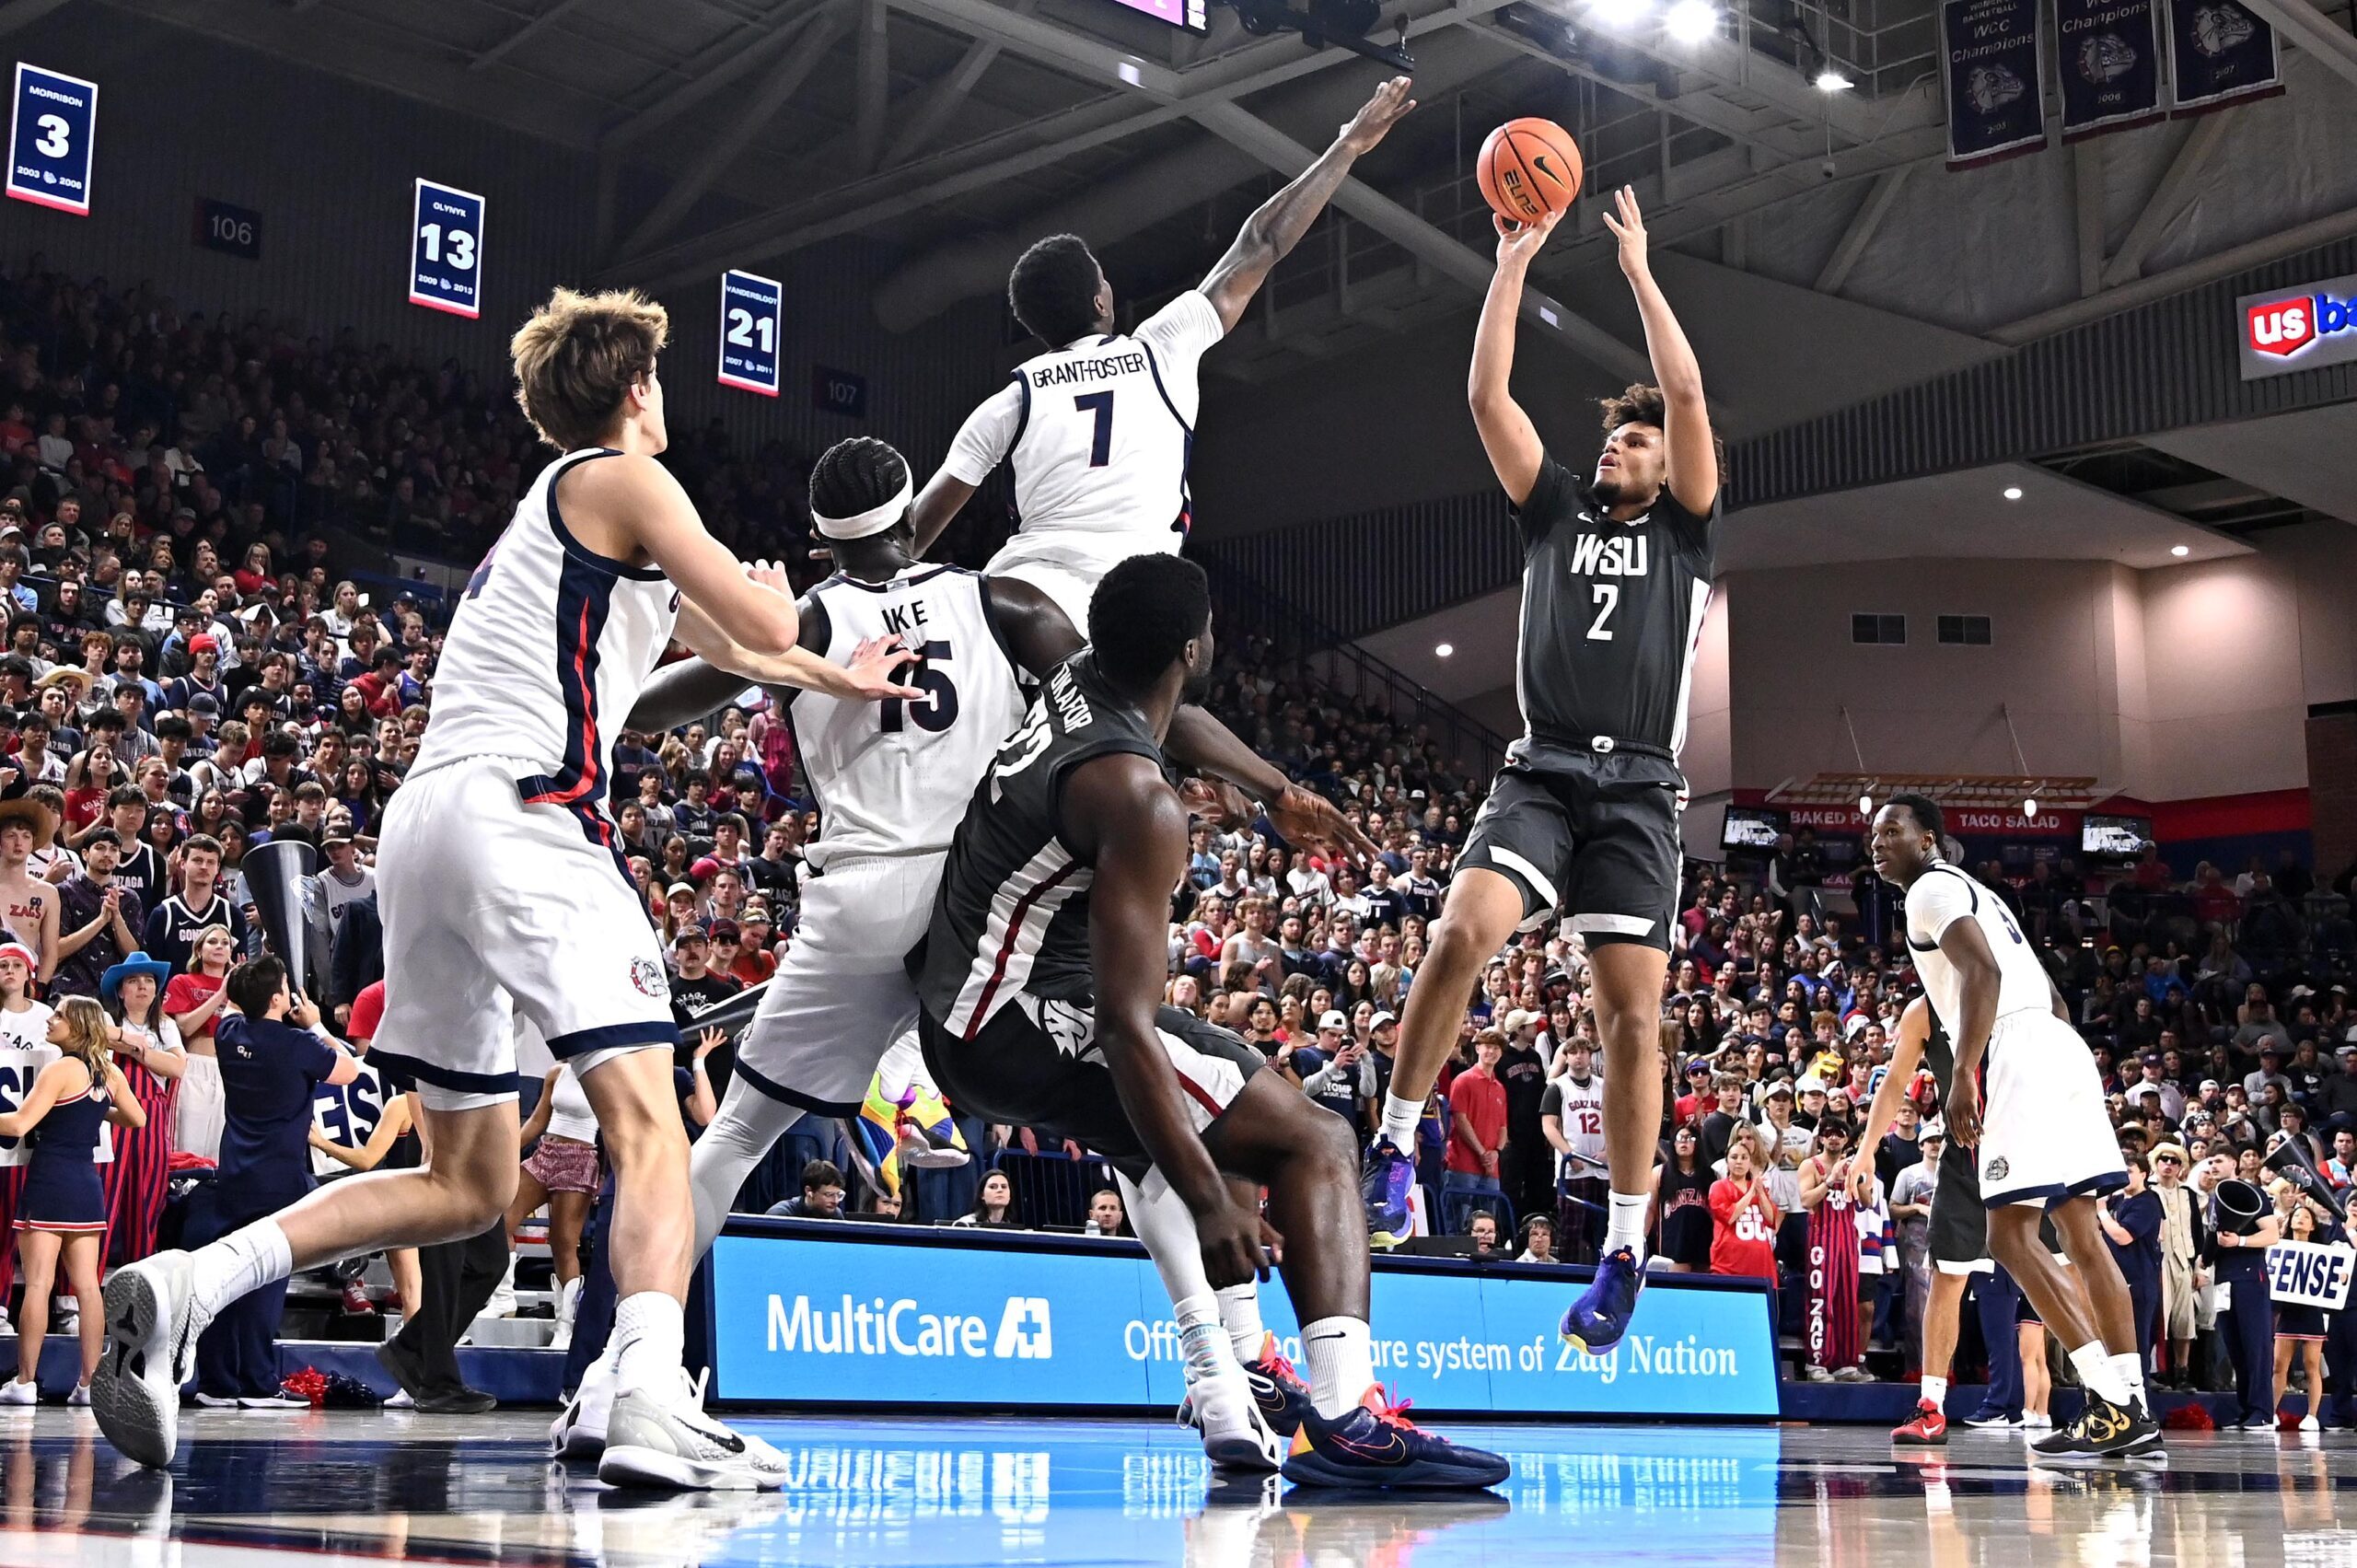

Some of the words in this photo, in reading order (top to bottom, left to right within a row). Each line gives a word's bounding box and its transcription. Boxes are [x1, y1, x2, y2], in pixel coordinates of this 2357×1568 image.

[1962, 3, 2017, 24] BASKETBALL
[2062, 2, 2148, 33] Champions
[1973, 18, 2010, 39] WCC
[1952, 32, 2034, 63] Champions
[29, 85, 83, 108] MORRISON
[35, 113, 70, 158] 3
[17, 165, 41, 179] 2003
[433, 201, 466, 217] OLYNYK
[211, 214, 252, 254] 106
[420, 223, 475, 271] 13
[418, 273, 437, 285] 2009
[453, 283, 473, 296] 2013
[726, 285, 777, 306] VANDERSLOOT
[727, 308, 774, 354] 21
[2253, 308, 2306, 345] us
[756, 364, 772, 375] 2011
[1032, 353, 1147, 389] GRANT-FOSTER
[829, 379, 857, 403] 107
[1074, 389, 1114, 468] 7
[1571, 534, 1647, 576] WSU
[881, 600, 928, 635] IKE
[1586, 584, 1620, 640] 2
[880, 640, 958, 733] 15
[1051, 661, 1094, 734] OKAFOR
[1790, 811, 1846, 825] BAKED
[1959, 814, 2002, 828] TACO
[2005, 815, 2061, 829] SALAD
[112, 876, 144, 889] NZAGA
[9, 903, 41, 920] ZAGS
[29, 897, 42, 907] GO
[1892, 900, 1906, 912] 10
[676, 992, 707, 1005] NZAGA
[1578, 1112, 1601, 1134] 12
[1664, 1188, 1707, 1219] GONZA
[1831, 1200, 1848, 1211] UP
[2267, 1249, 2345, 1299] FENSE
[768, 1294, 988, 1358] MultiCare
[1417, 1336, 1512, 1380] system
[1519, 1336, 1545, 1372] of
[1628, 1334, 1738, 1377] Nation
